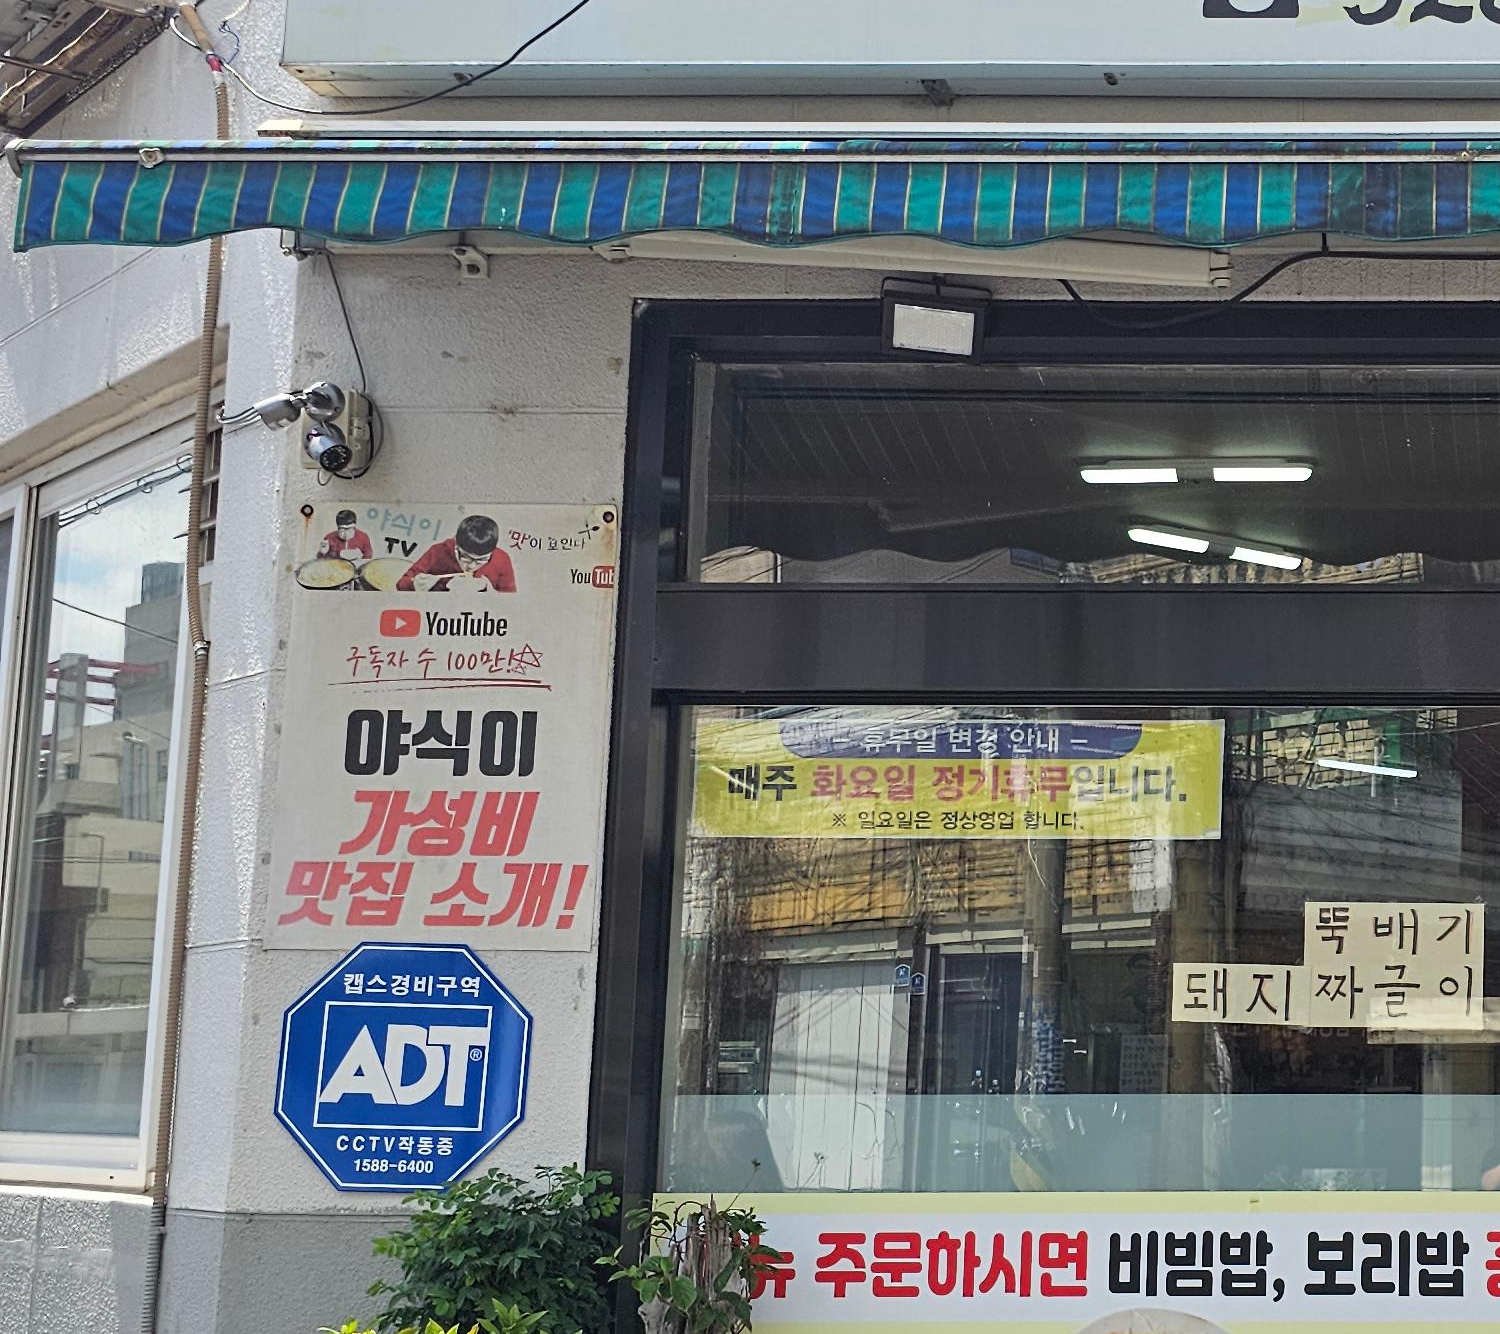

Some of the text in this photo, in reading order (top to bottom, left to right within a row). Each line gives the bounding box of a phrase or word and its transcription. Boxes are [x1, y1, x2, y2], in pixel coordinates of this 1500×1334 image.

[366, 508, 441, 540] 야식이
[384, 536, 418, 557] TV
[426, 612, 507, 636] YouTube
[346, 646, 408, 677] 구독자
[418, 648, 437, 679] 수
[345, 709, 537, 778] 야식이
[859, 728, 935, 753] 휴무일
[1011, 728, 1060, 754] 안내
[727, 766, 797, 801] 매주
[812, 766, 916, 802] 화요일
[338, 790, 541, 857] 가성비
[858, 811, 933, 830] 일요일은
[941, 811, 1015, 831] 정상영업
[278, 861, 589, 929] 맛집 소개!
[343, 972, 481, 998] 캡스경비구역
[321, 1024, 490, 1106] ADT
[336, 1135, 455, 1157] CCTV작동중
[353, 1158, 434, 1176] 1588-6400
[814, 1230, 1089, 1299] 주문하시면
[1108, 1230, 1286, 1303] 비빔밥,
[1304, 1230, 1470, 1299] 보리밥
